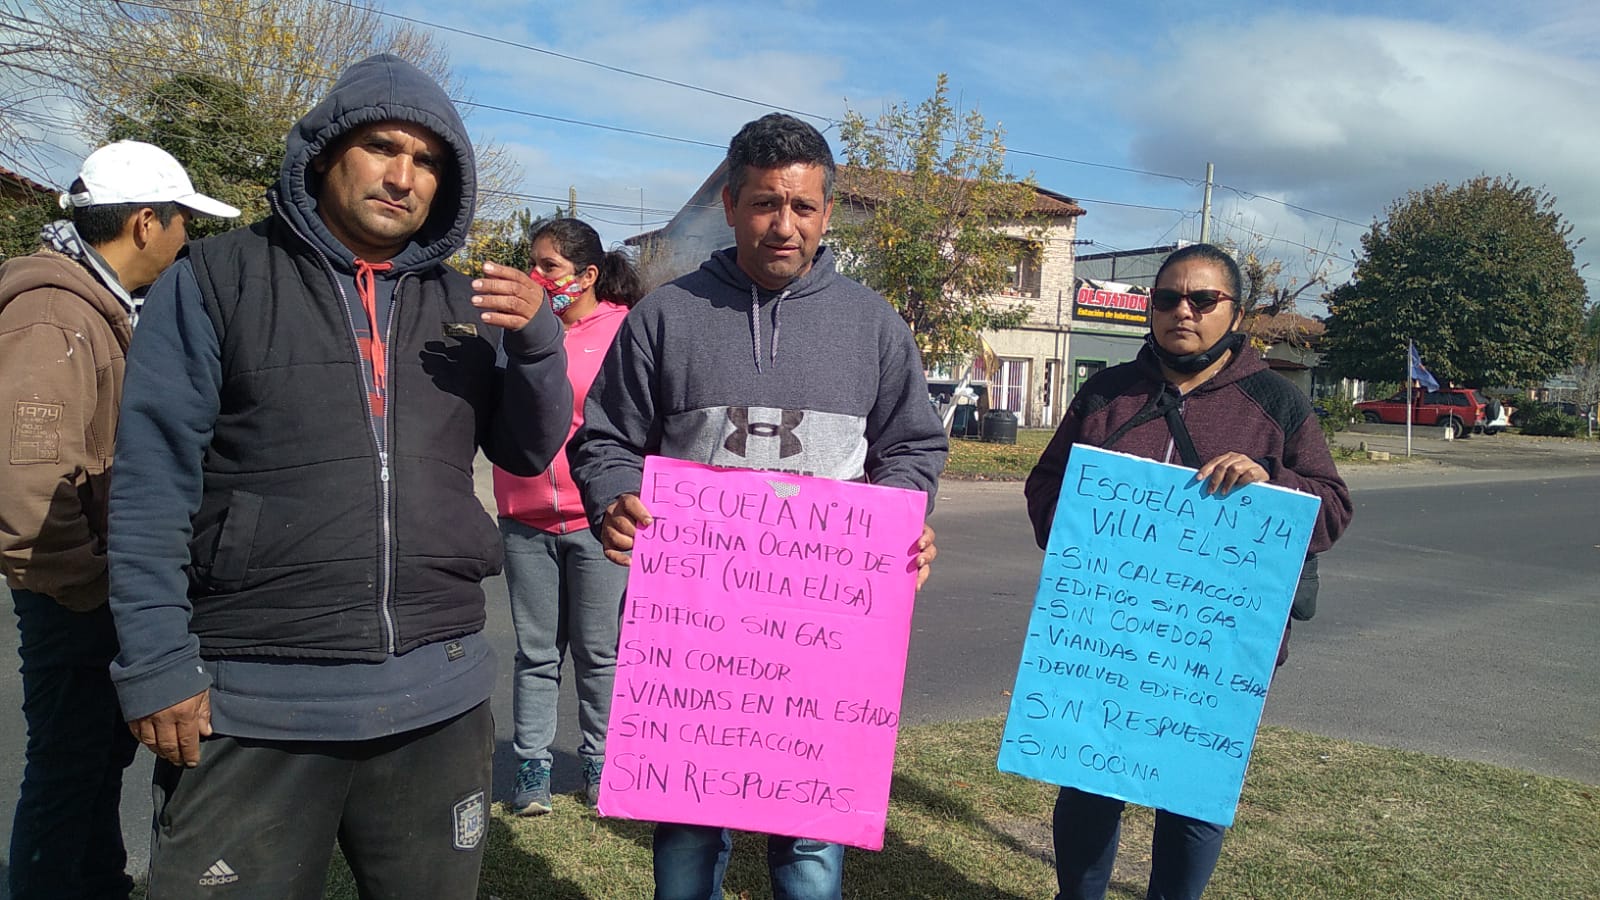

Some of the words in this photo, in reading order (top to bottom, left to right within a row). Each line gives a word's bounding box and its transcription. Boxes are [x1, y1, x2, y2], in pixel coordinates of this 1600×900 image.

[1105, 311, 1114, 319] de
[651, 472, 797, 530] ESCUELA
[842, 508, 873, 538] 14
[1077, 464, 1197, 520] ESCUELA
[1253, 515, 1293, 551] 14
[759, 530, 852, 567] OCAMPO
[858, 551, 896, 574] DE
[1177, 528, 1258, 571] ELISA
[723, 556, 793, 598] (VILLA
[803, 577, 874, 615] ELISA)
[795, 622, 844, 650] GAS
[1110, 609, 1214, 654] COMEDOR
[1197, 606, 1238, 629] GAS
[685, 649, 792, 683] COMEDOR
[1147, 651, 1179, 672] EN
[741, 693, 775, 715] EN
[785, 696, 825, 721] MAL
[1102, 698, 1244, 760] RESPUESTAS
[199, 876, 239, 886] adidas
